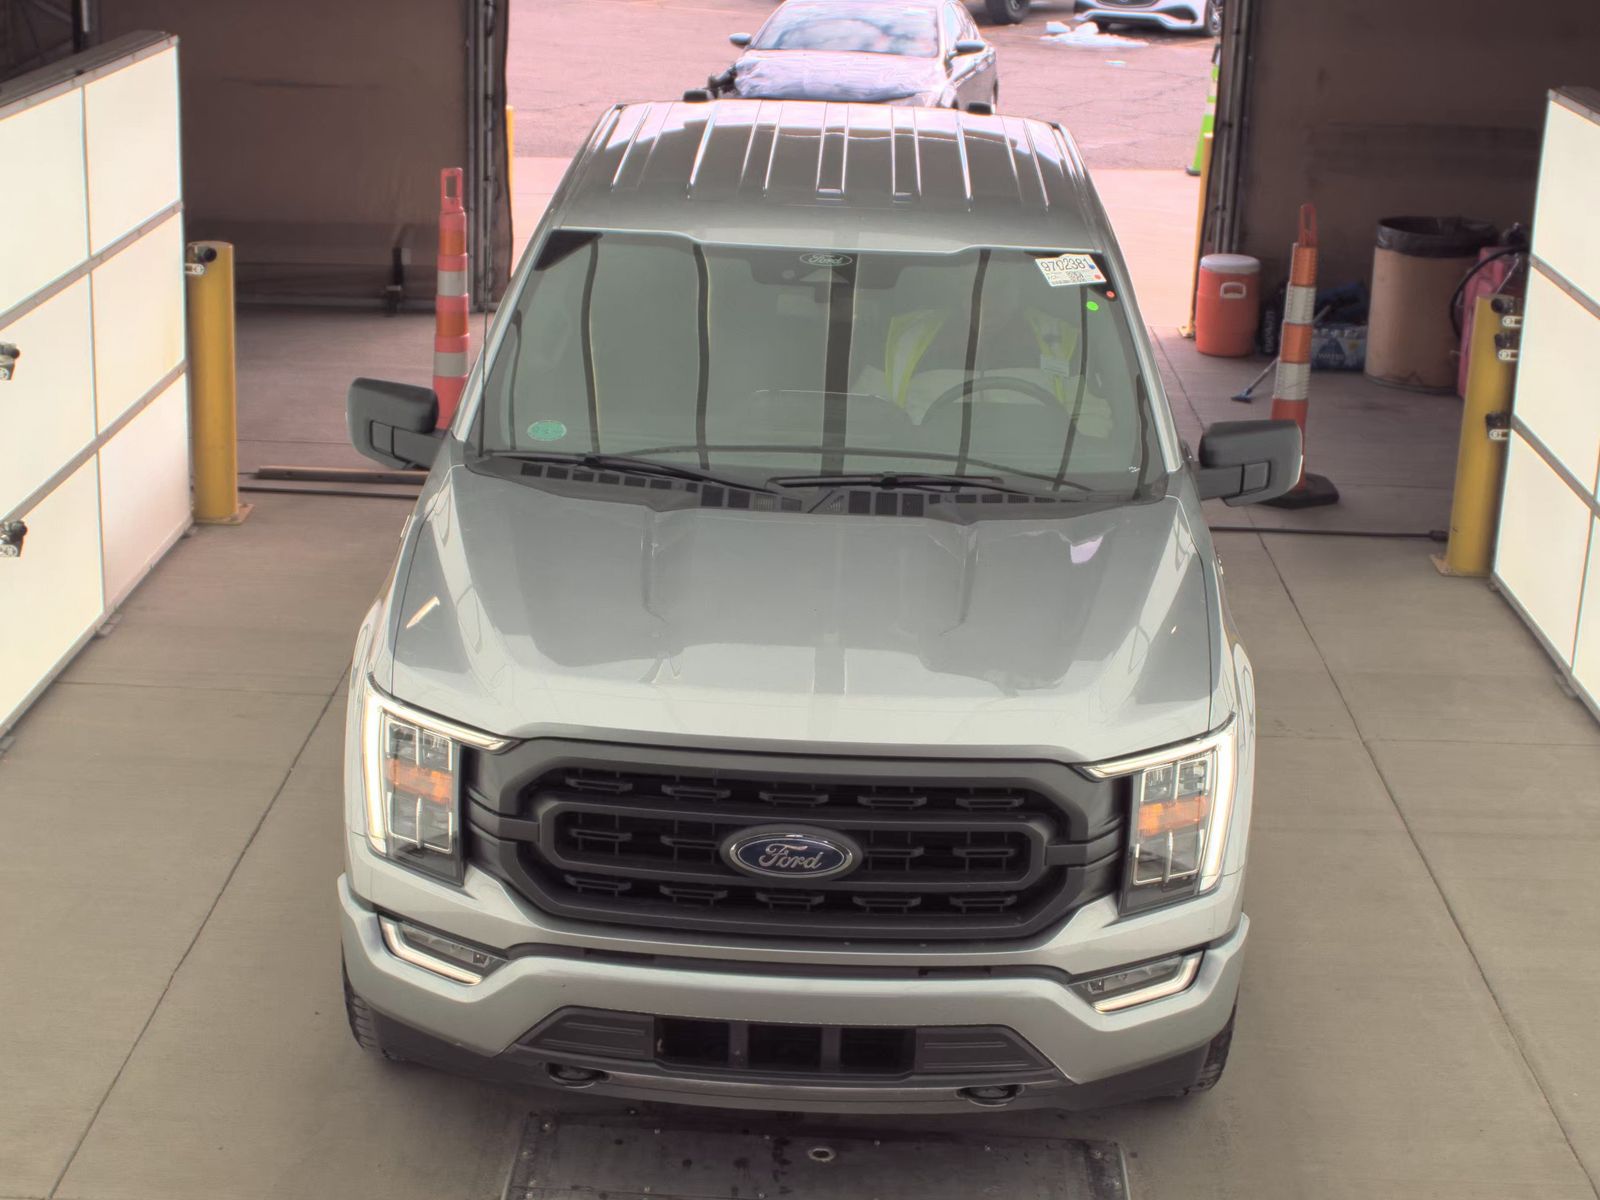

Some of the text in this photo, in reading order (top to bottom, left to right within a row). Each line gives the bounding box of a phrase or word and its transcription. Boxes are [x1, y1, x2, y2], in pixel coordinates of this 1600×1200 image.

[808, 254, 843, 264] Ford
[1040, 257, 1089, 272] 9702381
[758, 843, 823, 869] Ford
